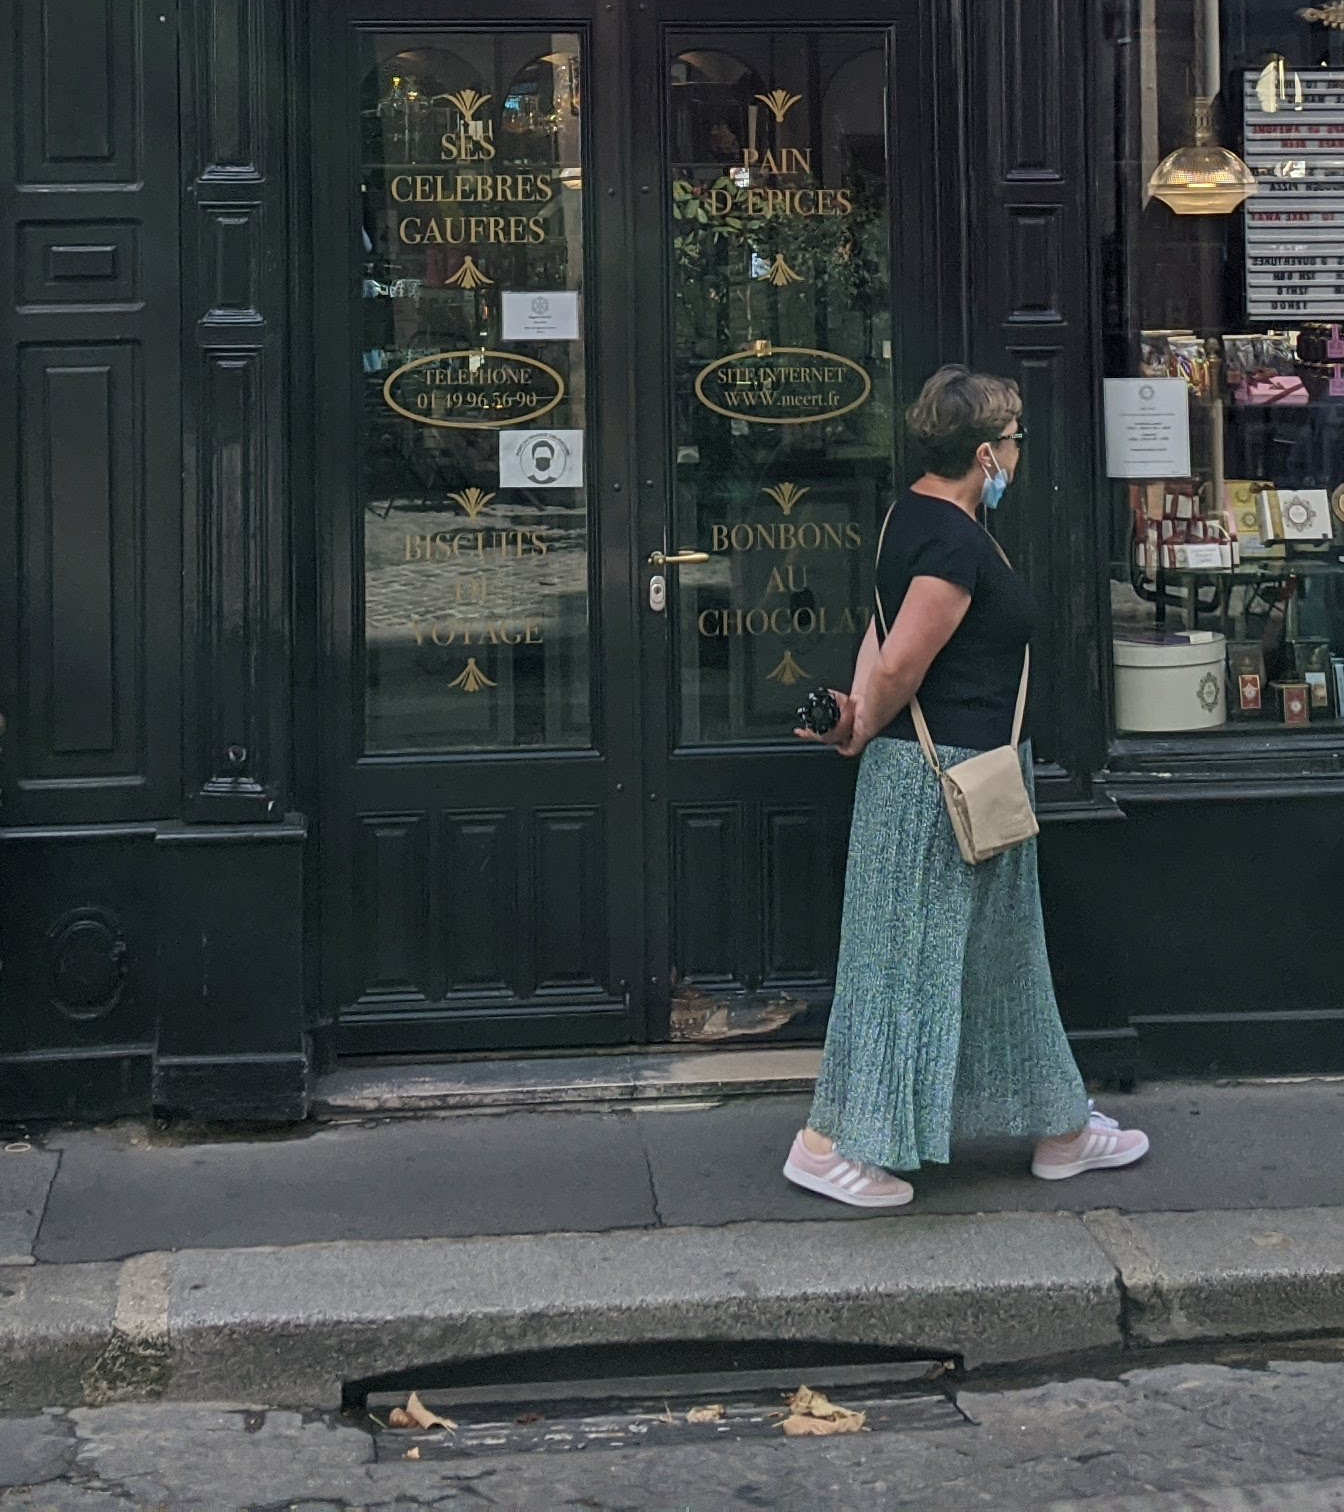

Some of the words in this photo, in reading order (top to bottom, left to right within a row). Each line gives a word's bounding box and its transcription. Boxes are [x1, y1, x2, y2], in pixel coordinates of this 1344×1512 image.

[441, 133, 496, 161] SES
[742, 147, 812, 175] PAIN
[390, 174, 553, 203] CELEBRES
[399, 216, 546, 245] GAUFRES
[424, 368, 532, 386] TELEPHONE
[717, 367, 756, 384] SITE
[759, 366, 846, 384] INTERNET
[405, 531, 548, 562] BISCUITS
[711, 522, 862, 552] BONBONS
[768, 564, 807, 592] AU
